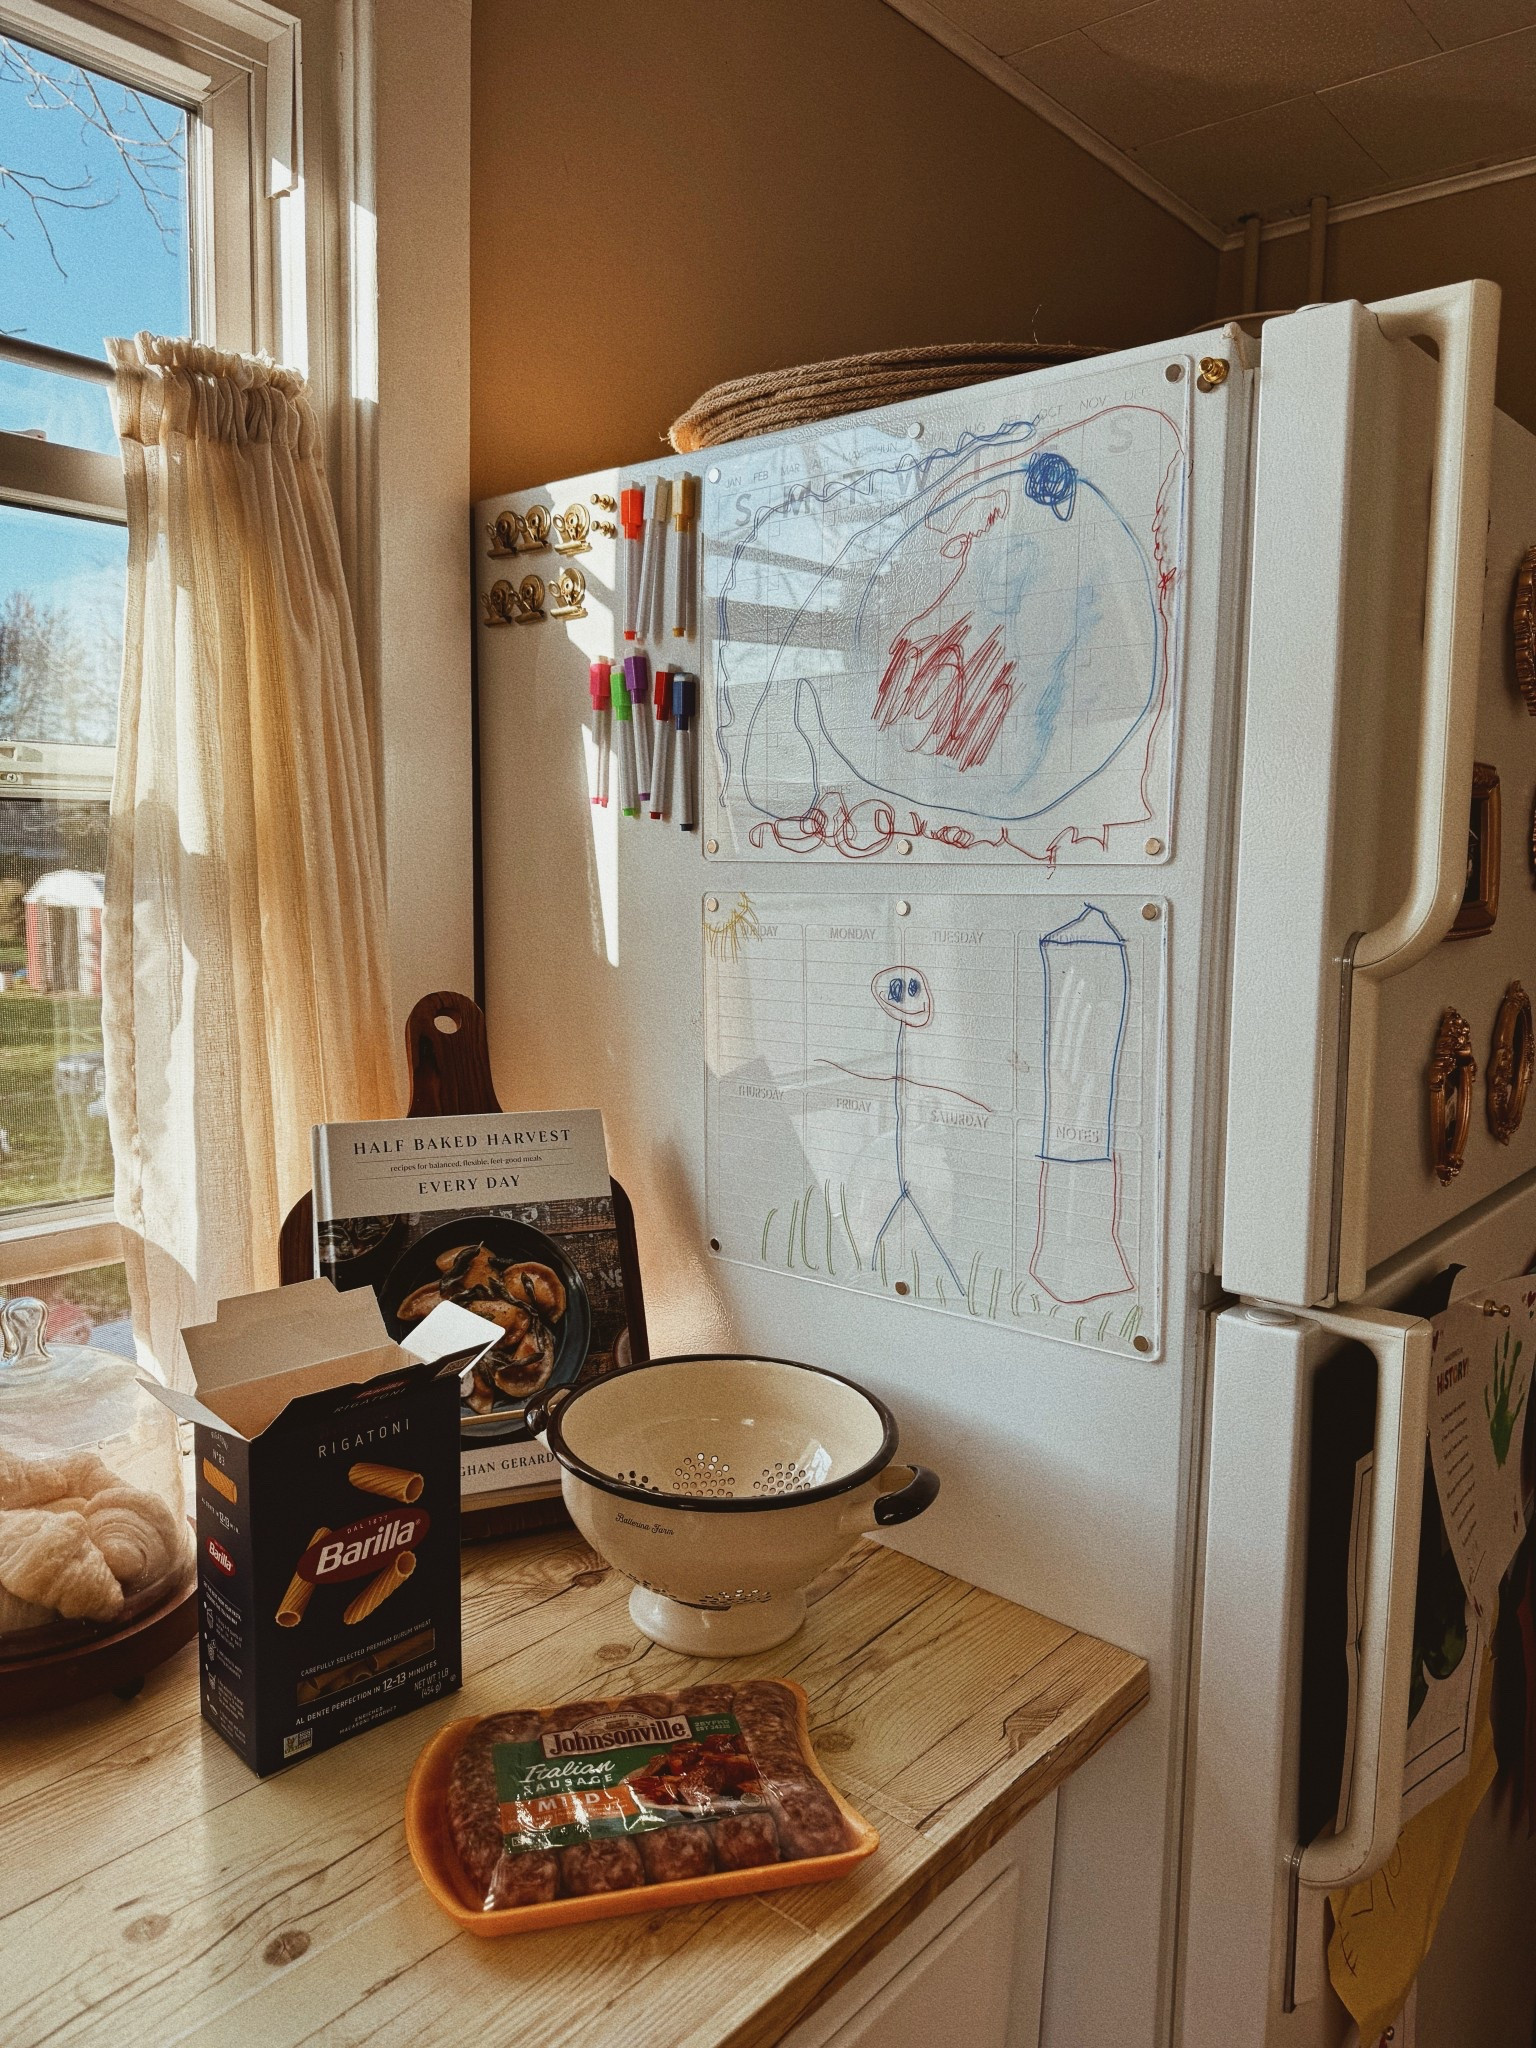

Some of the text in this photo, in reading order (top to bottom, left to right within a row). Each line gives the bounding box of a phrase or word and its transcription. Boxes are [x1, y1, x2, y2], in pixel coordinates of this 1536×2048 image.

[753, 470, 769, 482] FEB
[780, 464, 801, 476] MAR
[1080, 395, 1108, 412] NOV
[830, 926, 876, 941] MONDAY
[932, 930, 985, 945] TUESDAY
[738, 1085, 785, 1102] THURSDAY
[836, 1097, 872, 1114] FRIDAY
[929, 1109, 990, 1130] SATURDAY
[353, 1129, 571, 1156] HALF BAKED HARVEST
[1055, 1125, 1100, 1144] NOTES
[390, 1163, 416, 1173] recipes
[418, 1174, 521, 1196] EVERY DAY
[317, 1417, 409, 1459] RIGATONI
[346, 1513, 389, 1534] DAL 1877
[615, 1512, 675, 1536] Ballerina Farm
[208, 1540, 233, 1572] Barilla
[315, 1519, 416, 1576] Barilla
[300, 1617, 433, 1678] CAREFULLY SELECTED PREMIUM DURUM WHEAT
[414, 1679, 427, 1693] NET
[442, 1666, 449, 1681] LB
[295, 1658, 438, 1727] AL DENTE PERFECTION IN 12-13 MINUTES
[420, 1686, 435, 1700] (454
[550, 1720, 686, 1755] Johnsonville
[519, 1759, 617, 1783] Italian
[522, 1773, 614, 1796] SAUSAGE
